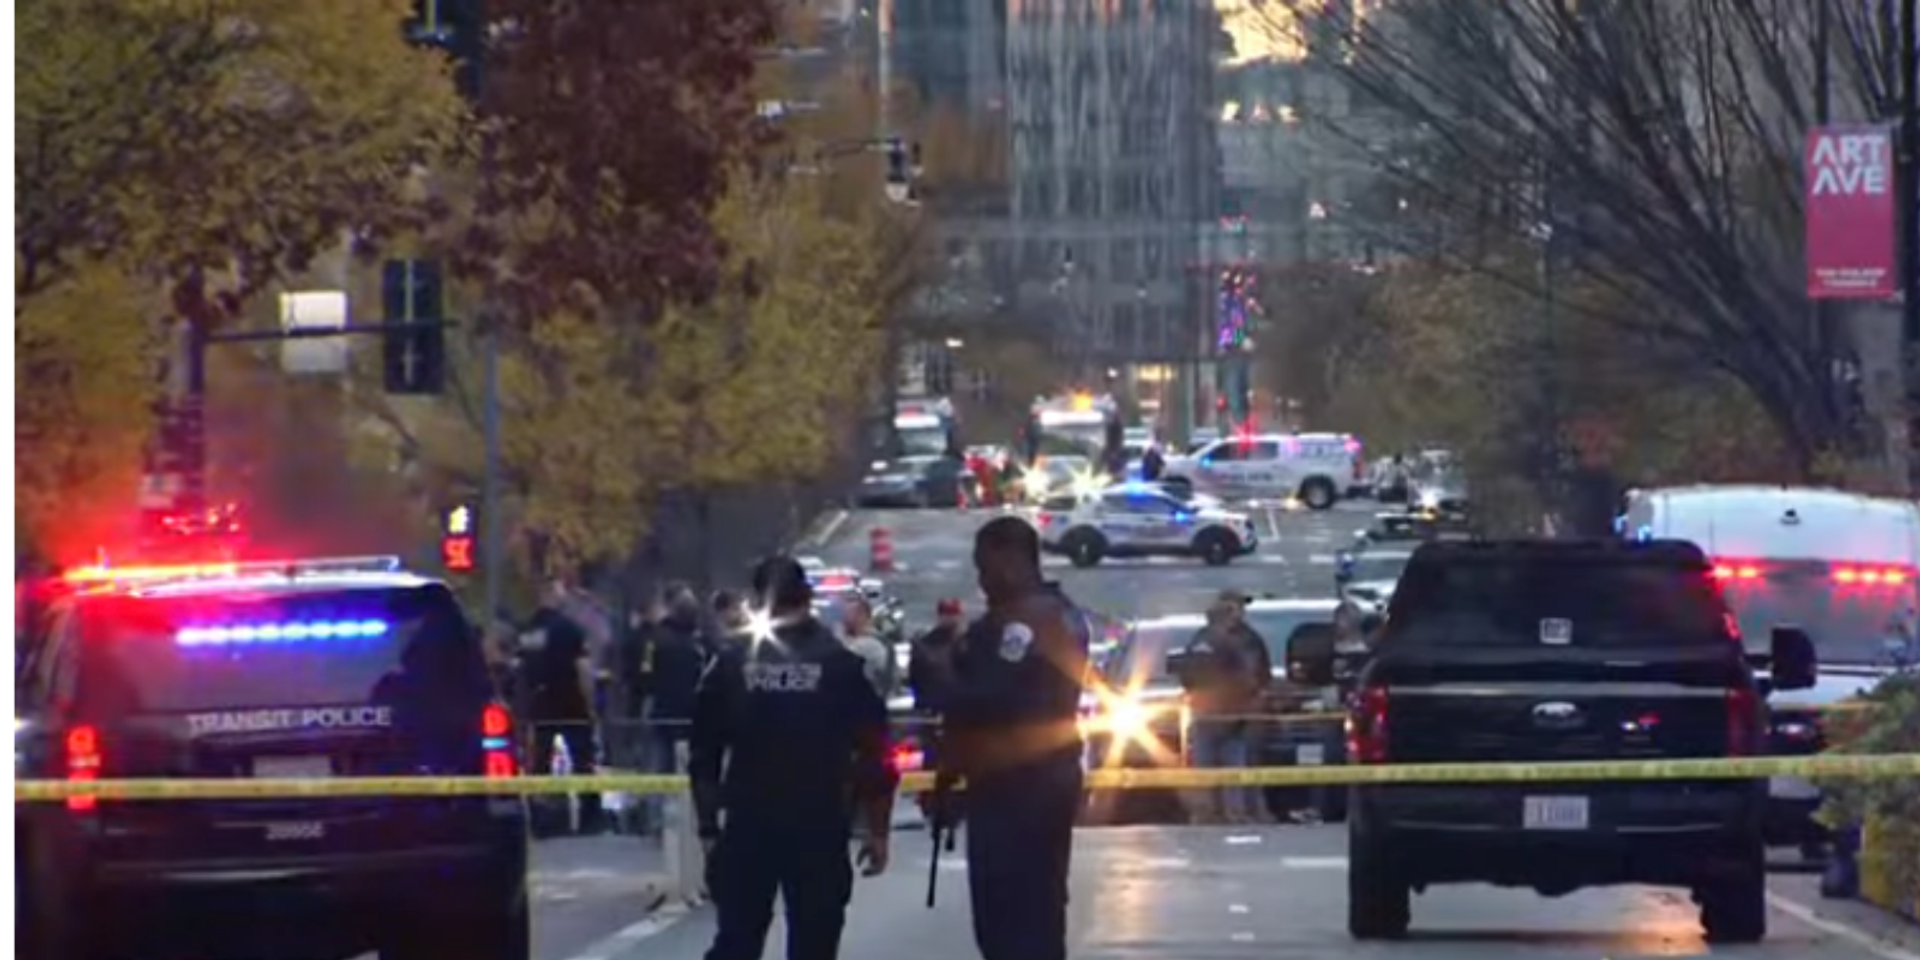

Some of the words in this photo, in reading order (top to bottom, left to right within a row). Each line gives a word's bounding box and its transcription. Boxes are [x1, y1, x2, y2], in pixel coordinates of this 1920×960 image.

[1812, 134, 1885, 165] ART
[1812, 165, 1885, 195] AVE
[186, 708, 293, 738] TRANSIT
[302, 705, 392, 728] POLICE
